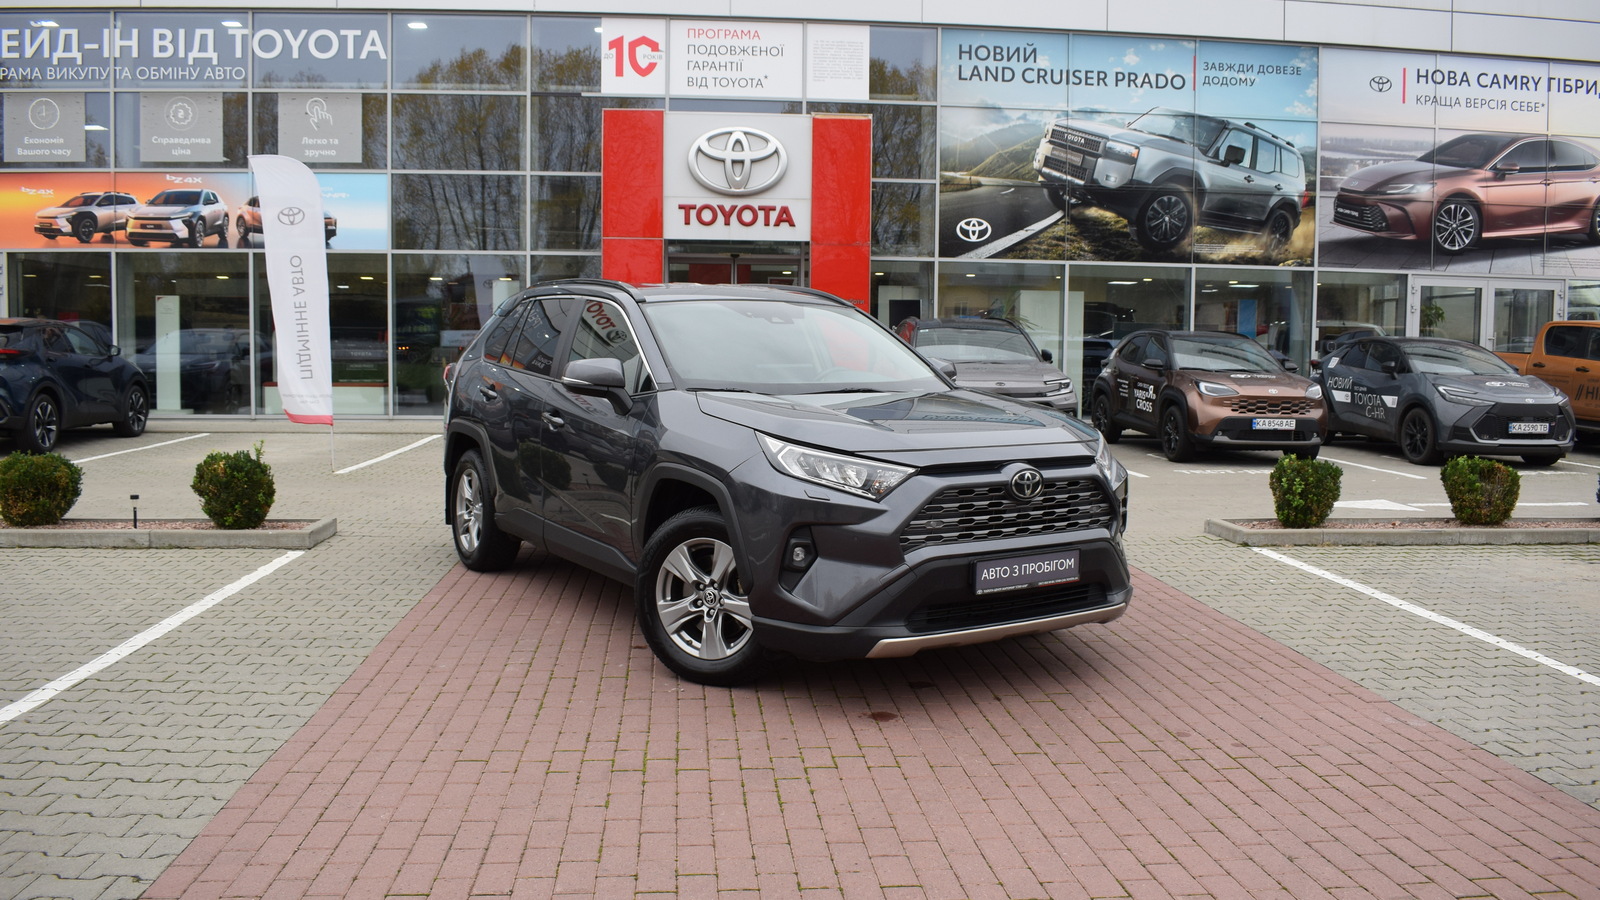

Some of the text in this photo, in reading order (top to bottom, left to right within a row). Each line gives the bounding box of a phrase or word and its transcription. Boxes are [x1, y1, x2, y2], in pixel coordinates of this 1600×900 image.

[687, 28, 761, 40] ПРОГРАМА
[153, 29, 218, 65] ВІД
[228, 29, 388, 60] TOYOTA
[687, 44, 785, 57] ПОДОВЖЕНОЇ
[958, 43, 1038, 64] НОВИЙ
[687, 61, 743, 72] ГАРАНТІЇ
[1202, 61, 1303, 76] ЗАВЖДИ ДОВЕЗЕ
[47, 67, 110, 80] ВИКУПУ
[114, 67, 132, 80] ТА
[136, 67, 200, 80] ОБМІНУ
[204, 67, 246, 80] АВТО
[958, 65, 1187, 90] LAND CRUISER PRADO
[687, 77, 709, 90] ВІД
[1202, 75, 1257, 88] ДОДОМУ
[1416, 68, 1600, 99] НОВА CAMRY ГІБРИ
[1416, 95, 1461, 109] КРАЩА
[1465, 98, 1507, 110] ВЕРСІЯ
[24, 136, 64, 144] Економія
[152, 136, 211, 145] Справедлива
[302, 137, 327, 145] Легко
[1064, 134, 1085, 144] TOYOTA
[17, 147, 72, 157] Вашого часу
[172, 147, 191, 156] ціна
[304, 149, 337, 158] зручно
[678, 204, 796, 227] TOYOTA
[1327, 376, 1353, 390] НОВИЙ
[1354, 392, 1381, 406] TOYOTA
[1136, 399, 1153, 413] CROSS
[1365, 406, 1386, 419] C-HR
[1267, 420, 1284, 428] 8548
[1284, 420, 1295, 428] AE
[981, 558, 1075, 580] АВТО З ПРОБІГОМ
